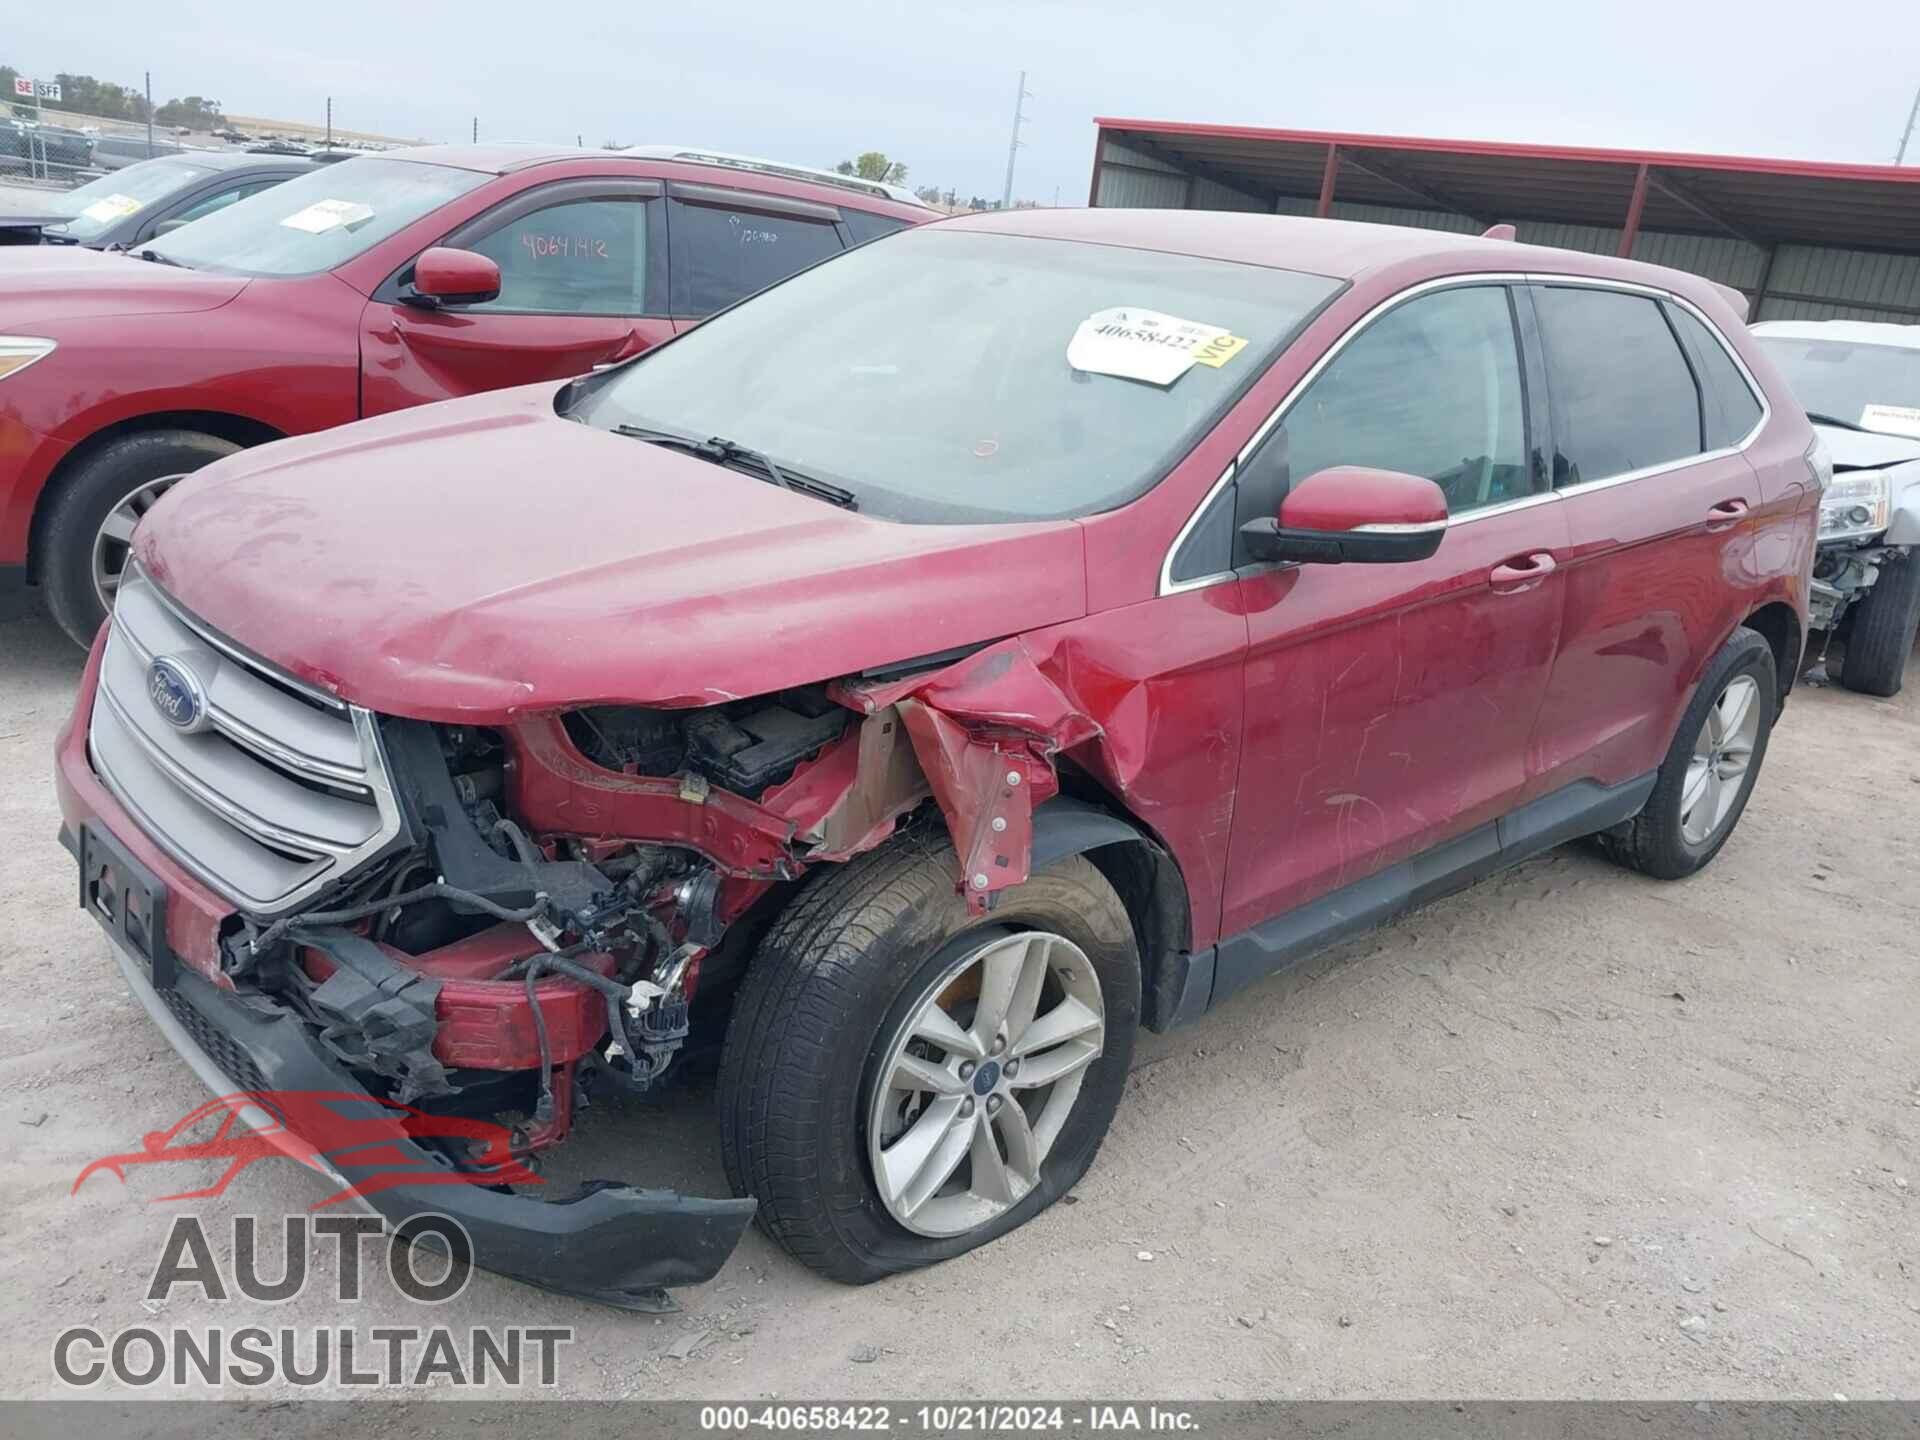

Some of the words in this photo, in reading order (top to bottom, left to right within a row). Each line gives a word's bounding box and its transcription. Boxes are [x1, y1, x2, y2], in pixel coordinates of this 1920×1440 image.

[17, 80, 33, 93] SE
[39, 84, 59, 97] SFF
[1094, 323, 1198, 350] 40658422
[1193, 334, 1236, 361] VIC
[151, 670, 185, 717] Ford
